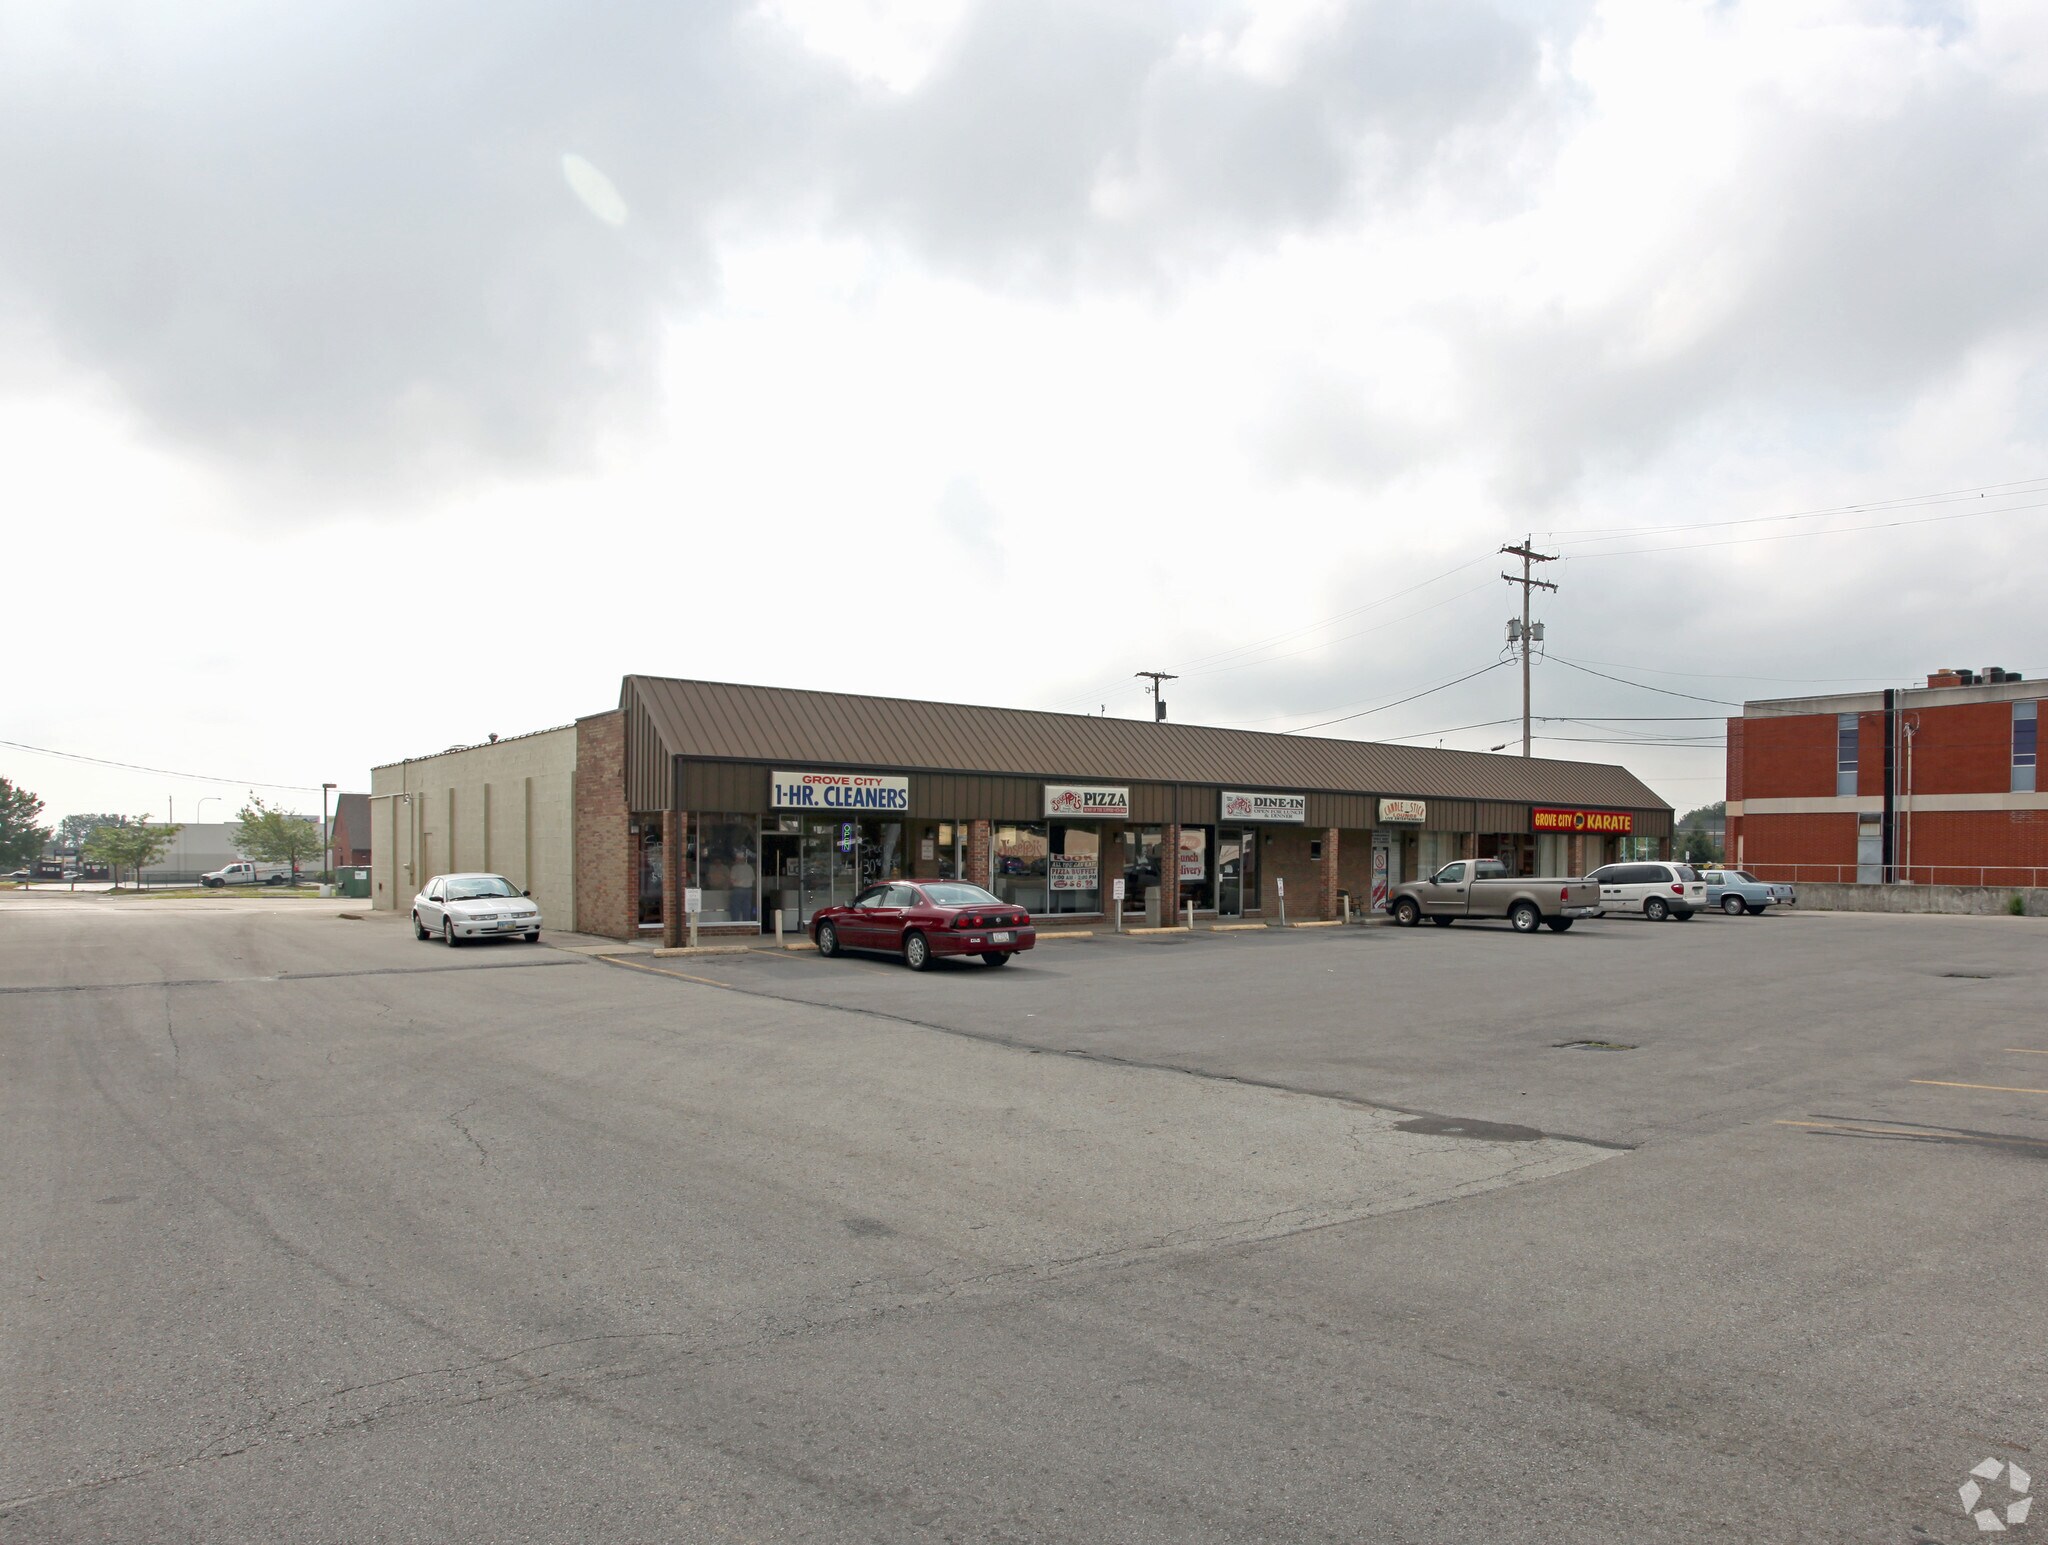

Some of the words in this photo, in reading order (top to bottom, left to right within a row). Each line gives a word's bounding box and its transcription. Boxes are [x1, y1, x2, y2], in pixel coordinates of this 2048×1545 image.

[803, 776, 850, 785] GROVE
[854, 777, 883, 786] CITY
[775, 784, 819, 806] 1-HR.
[824, 786, 907, 809] CLEANERS
[1083, 793, 1127, 806] PIZZA
[1254, 797, 1304, 809] DINE-IN
[1535, 813, 1557, 827] GROVE
[1558, 814, 1573, 827] CITY
[1587, 814, 1631, 830] KARATE
[1181, 852, 1199, 862] unch
[1181, 864, 1202, 876] livery
